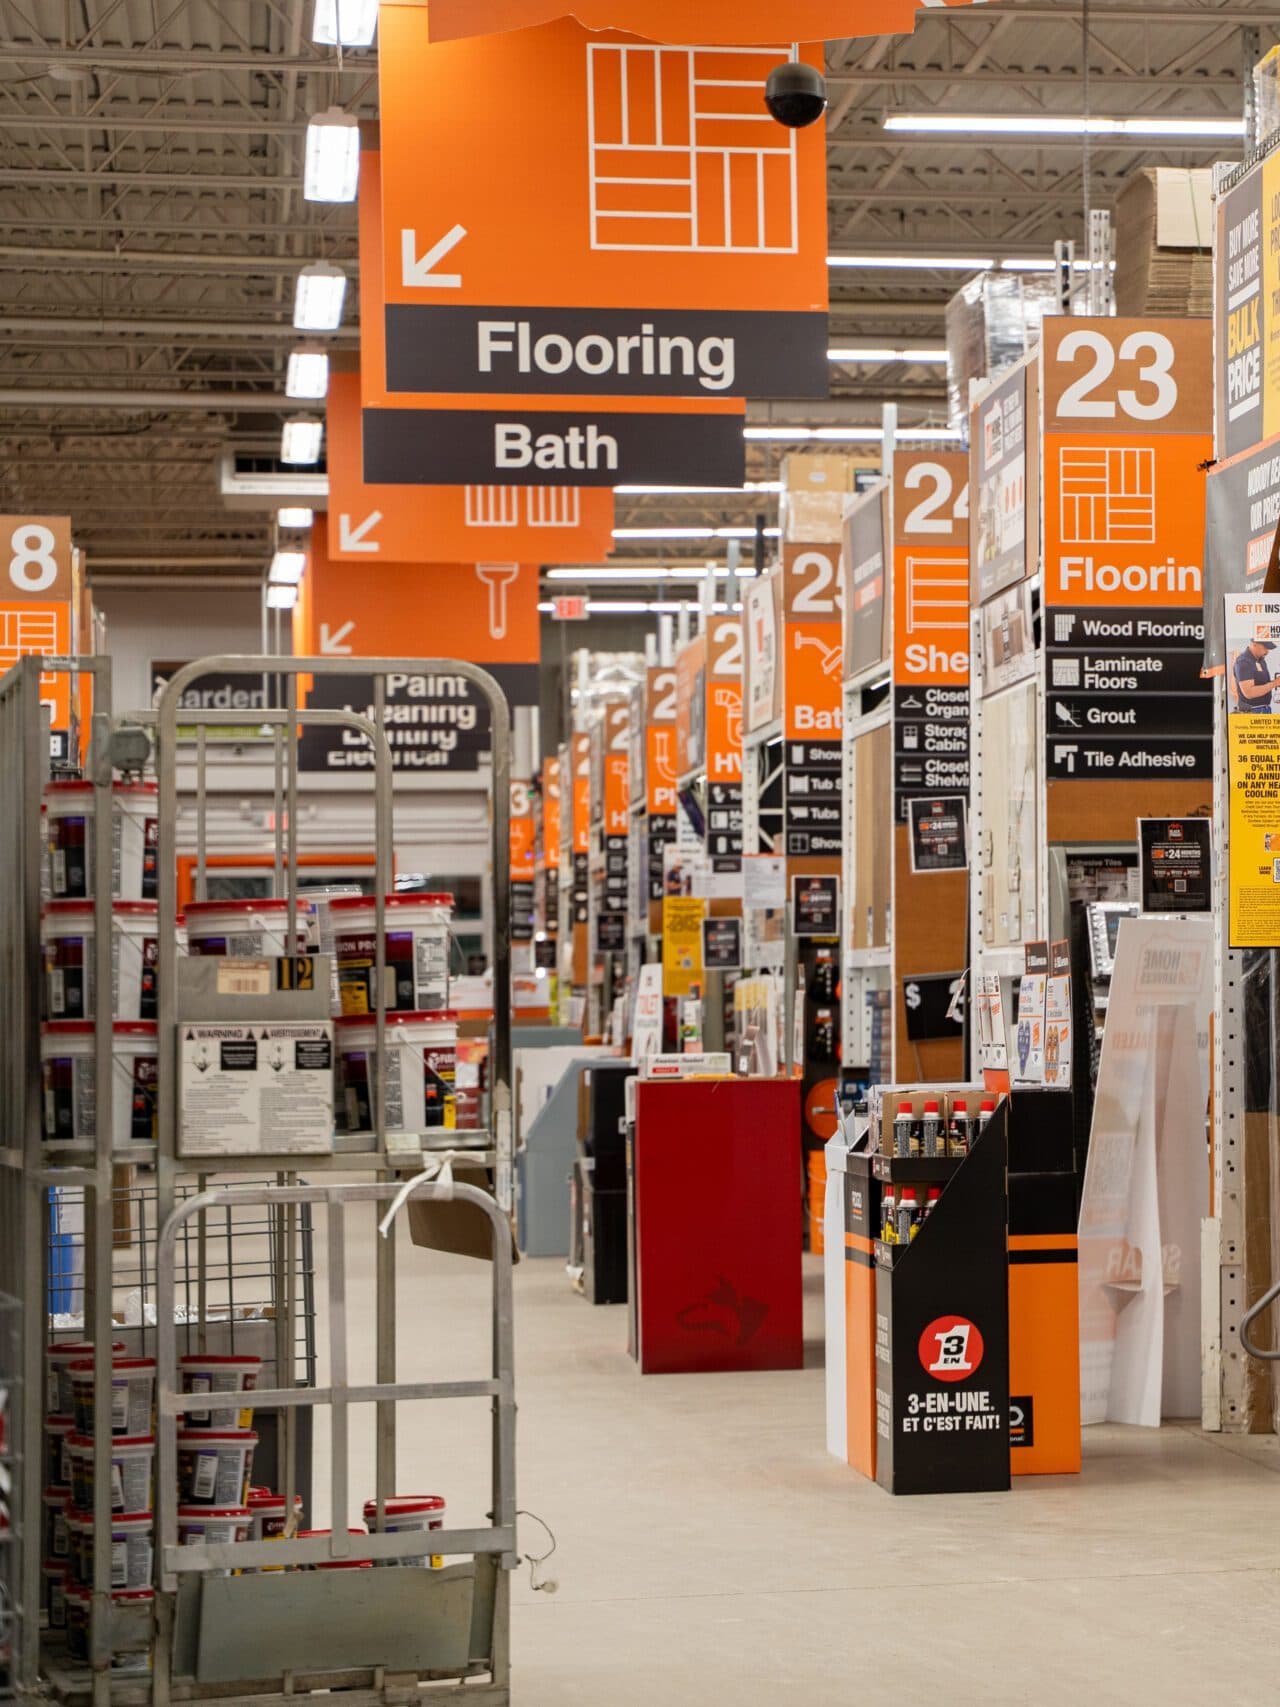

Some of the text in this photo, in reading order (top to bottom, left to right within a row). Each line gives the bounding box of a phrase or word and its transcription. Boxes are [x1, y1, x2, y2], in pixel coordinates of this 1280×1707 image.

[1228, 299, 1260, 353] BULK
[478, 321, 735, 390] Flooring
[1055, 330, 1178, 420] 23
[1228, 349, 1261, 404] PRICE
[494, 425, 618, 471] Bath
[1248, 463, 1270, 497] NOBODY
[1250, 500, 1262, 532] OUR
[9, 524, 58, 592] 8
[1059, 557, 1201, 593] Floorin
[1236, 604, 1253, 613] GET
[1255, 604, 1263, 613] IT
[1083, 619, 1205, 640] Wood Flooring
[1084, 657, 1163, 673] Laminate
[387, 673, 468, 697] Paint
[1084, 673, 1138, 689] Floors
[1087, 708, 1136, 724] Grout
[1083, 751, 1196, 768] Tile Adhesive
[1238, 755, 1248, 763] 36
[1250, 755, 1274, 763] EQUAL
[1251, 764, 1264, 772] 0%
[1237, 782, 1248, 790] ON
[1250, 782, 1266, 790] ANY
[1245, 773, 1256, 781] NO
[1245, 790, 1278, 798] COOLING
[811, 807, 839, 820] Tubs
[1169, 849, 1180, 859] 24
[281, 957, 313, 990] 12
[944, 1336, 965, 1355] 3
[908, 1391, 995, 1414] 3-EN-UNE.
[903, 1415, 1000, 1432] ET C'EST FAIT!
